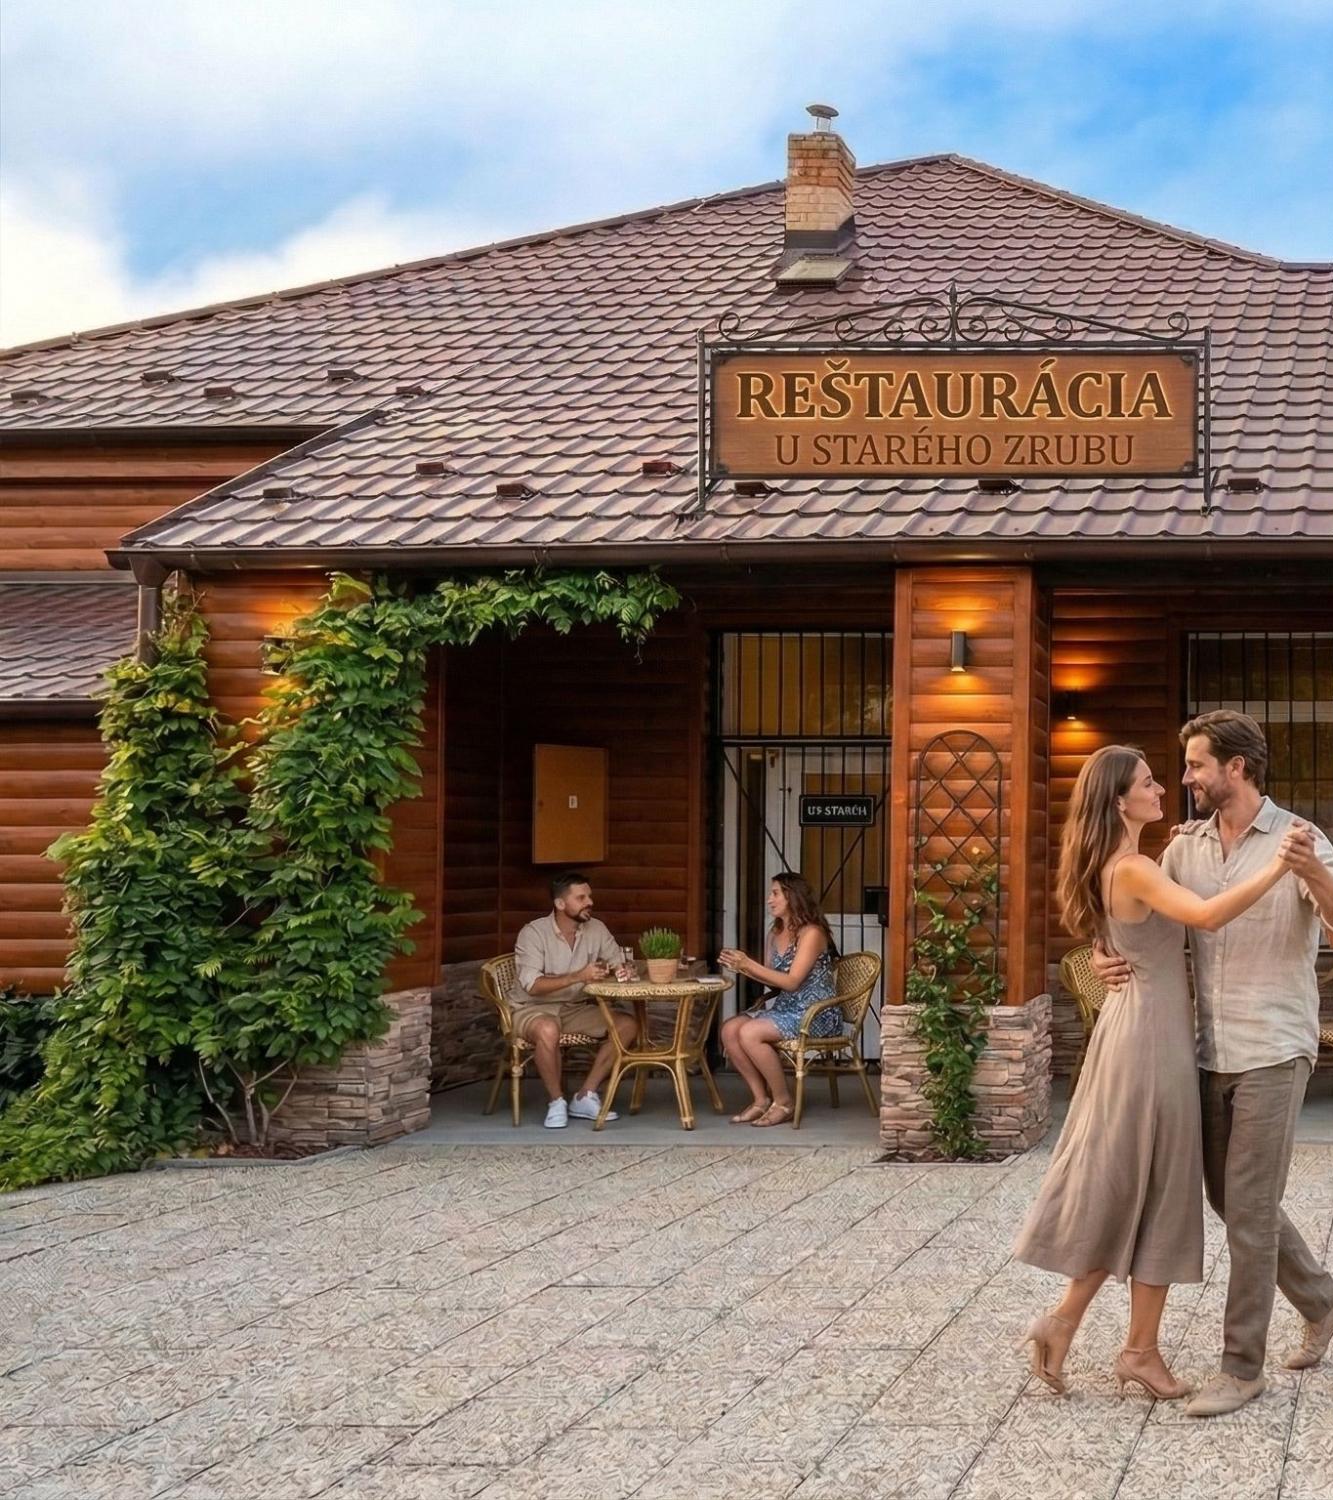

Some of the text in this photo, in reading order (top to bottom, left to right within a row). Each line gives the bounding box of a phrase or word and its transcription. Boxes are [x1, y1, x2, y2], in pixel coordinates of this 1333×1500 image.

[736, 358, 1173, 420] REŠTAURÁCIA
[775, 426, 1135, 465] U STARÉHO ZRUBU
